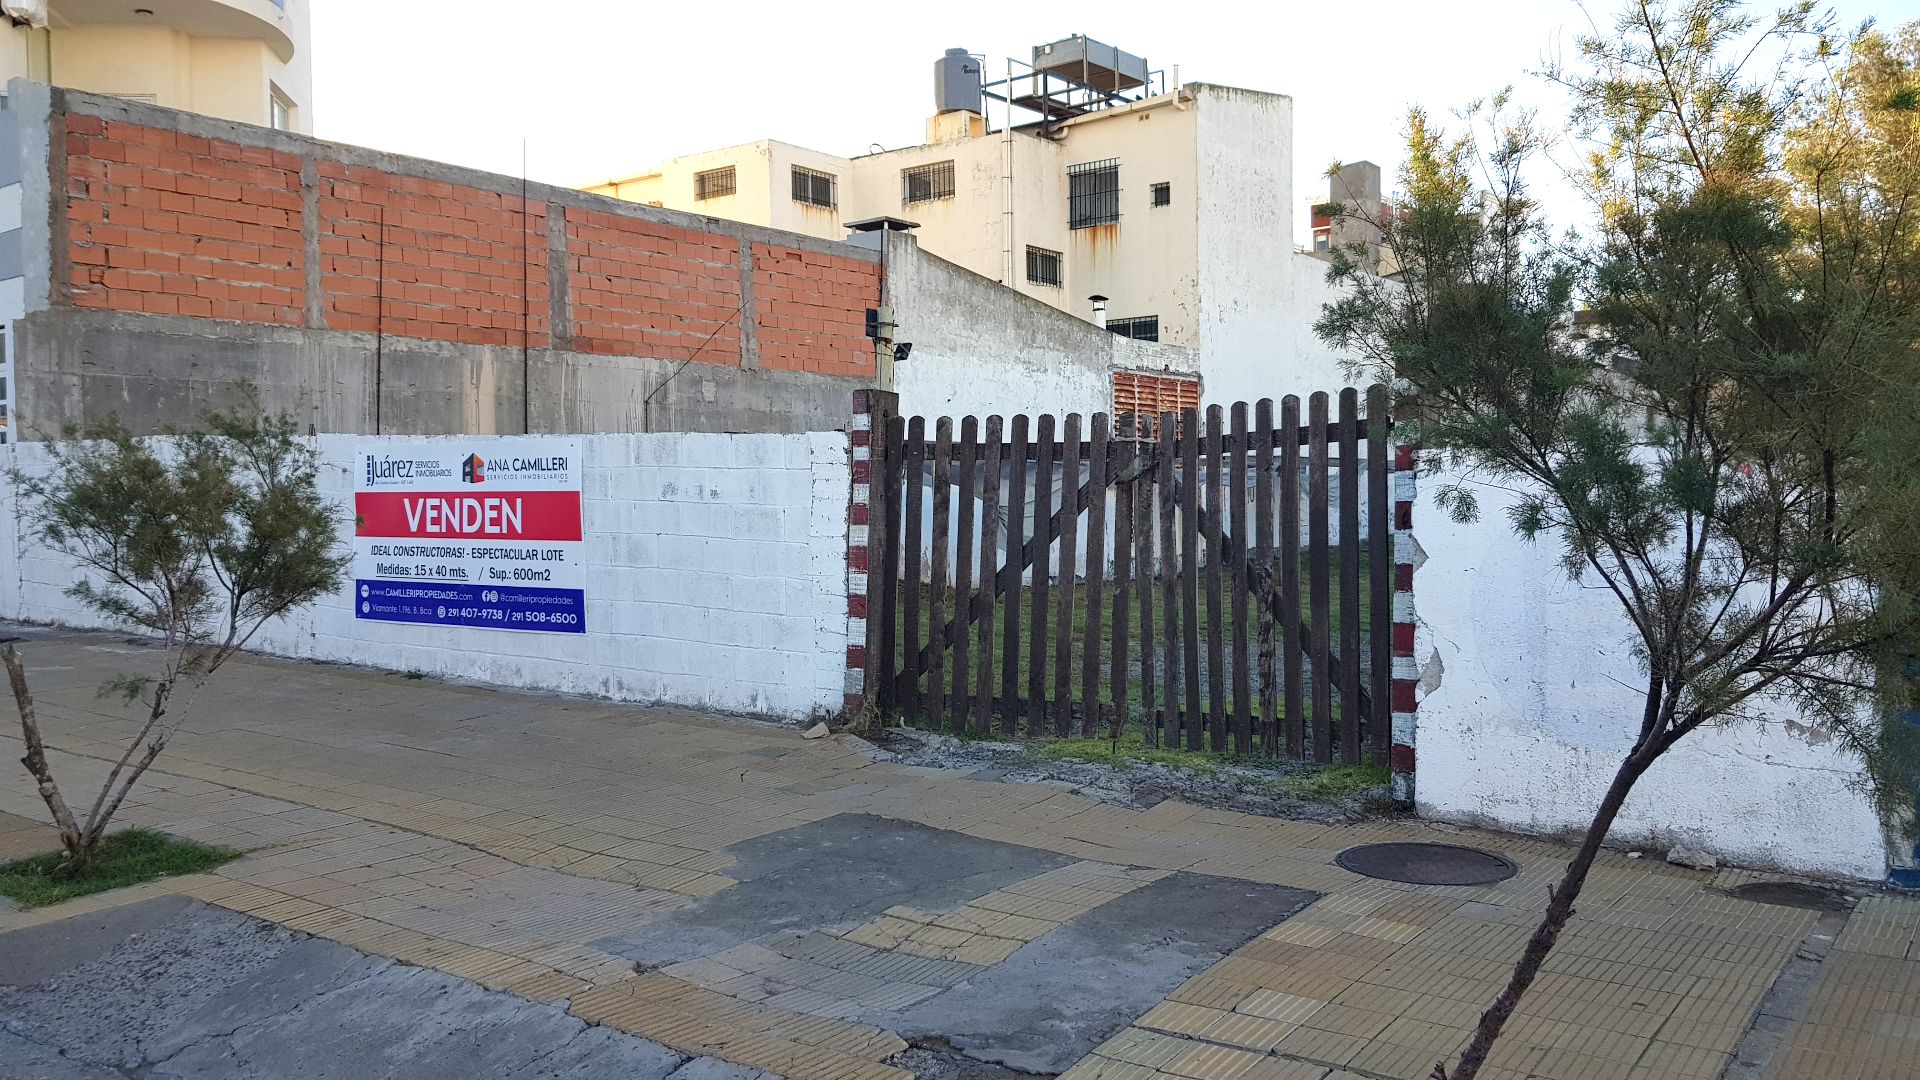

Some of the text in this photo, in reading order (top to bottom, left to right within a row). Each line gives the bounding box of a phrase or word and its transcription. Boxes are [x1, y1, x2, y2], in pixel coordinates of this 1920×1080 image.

[371, 454, 414, 486] Juárez
[415, 460, 439, 469] SERVICIOS
[487, 457, 568, 472] ANA CAMILLERI
[415, 469, 452, 477] INMOBILIARIOS
[403, 497, 523, 534] VENDEN
[371, 545, 392, 556] IDEAL
[393, 545, 465, 558] CONSTRUCTORAS!
[472, 548, 539, 561] ESPECTACULAR
[541, 549, 564, 561] LOTE
[376, 563, 551, 582] Medidas: 15 x 40 mts. / Sup.: 600m2
[371, 587, 574, 606] www.CAMILLERIPROPIEDADES.com @camilleripropiedades
[448, 608, 460, 617] 291
[461, 608, 503, 620] 407-9738
[505, 609, 511, 622] /
[512, 612, 524, 621] 291
[525, 611, 578, 624] 508-6500
